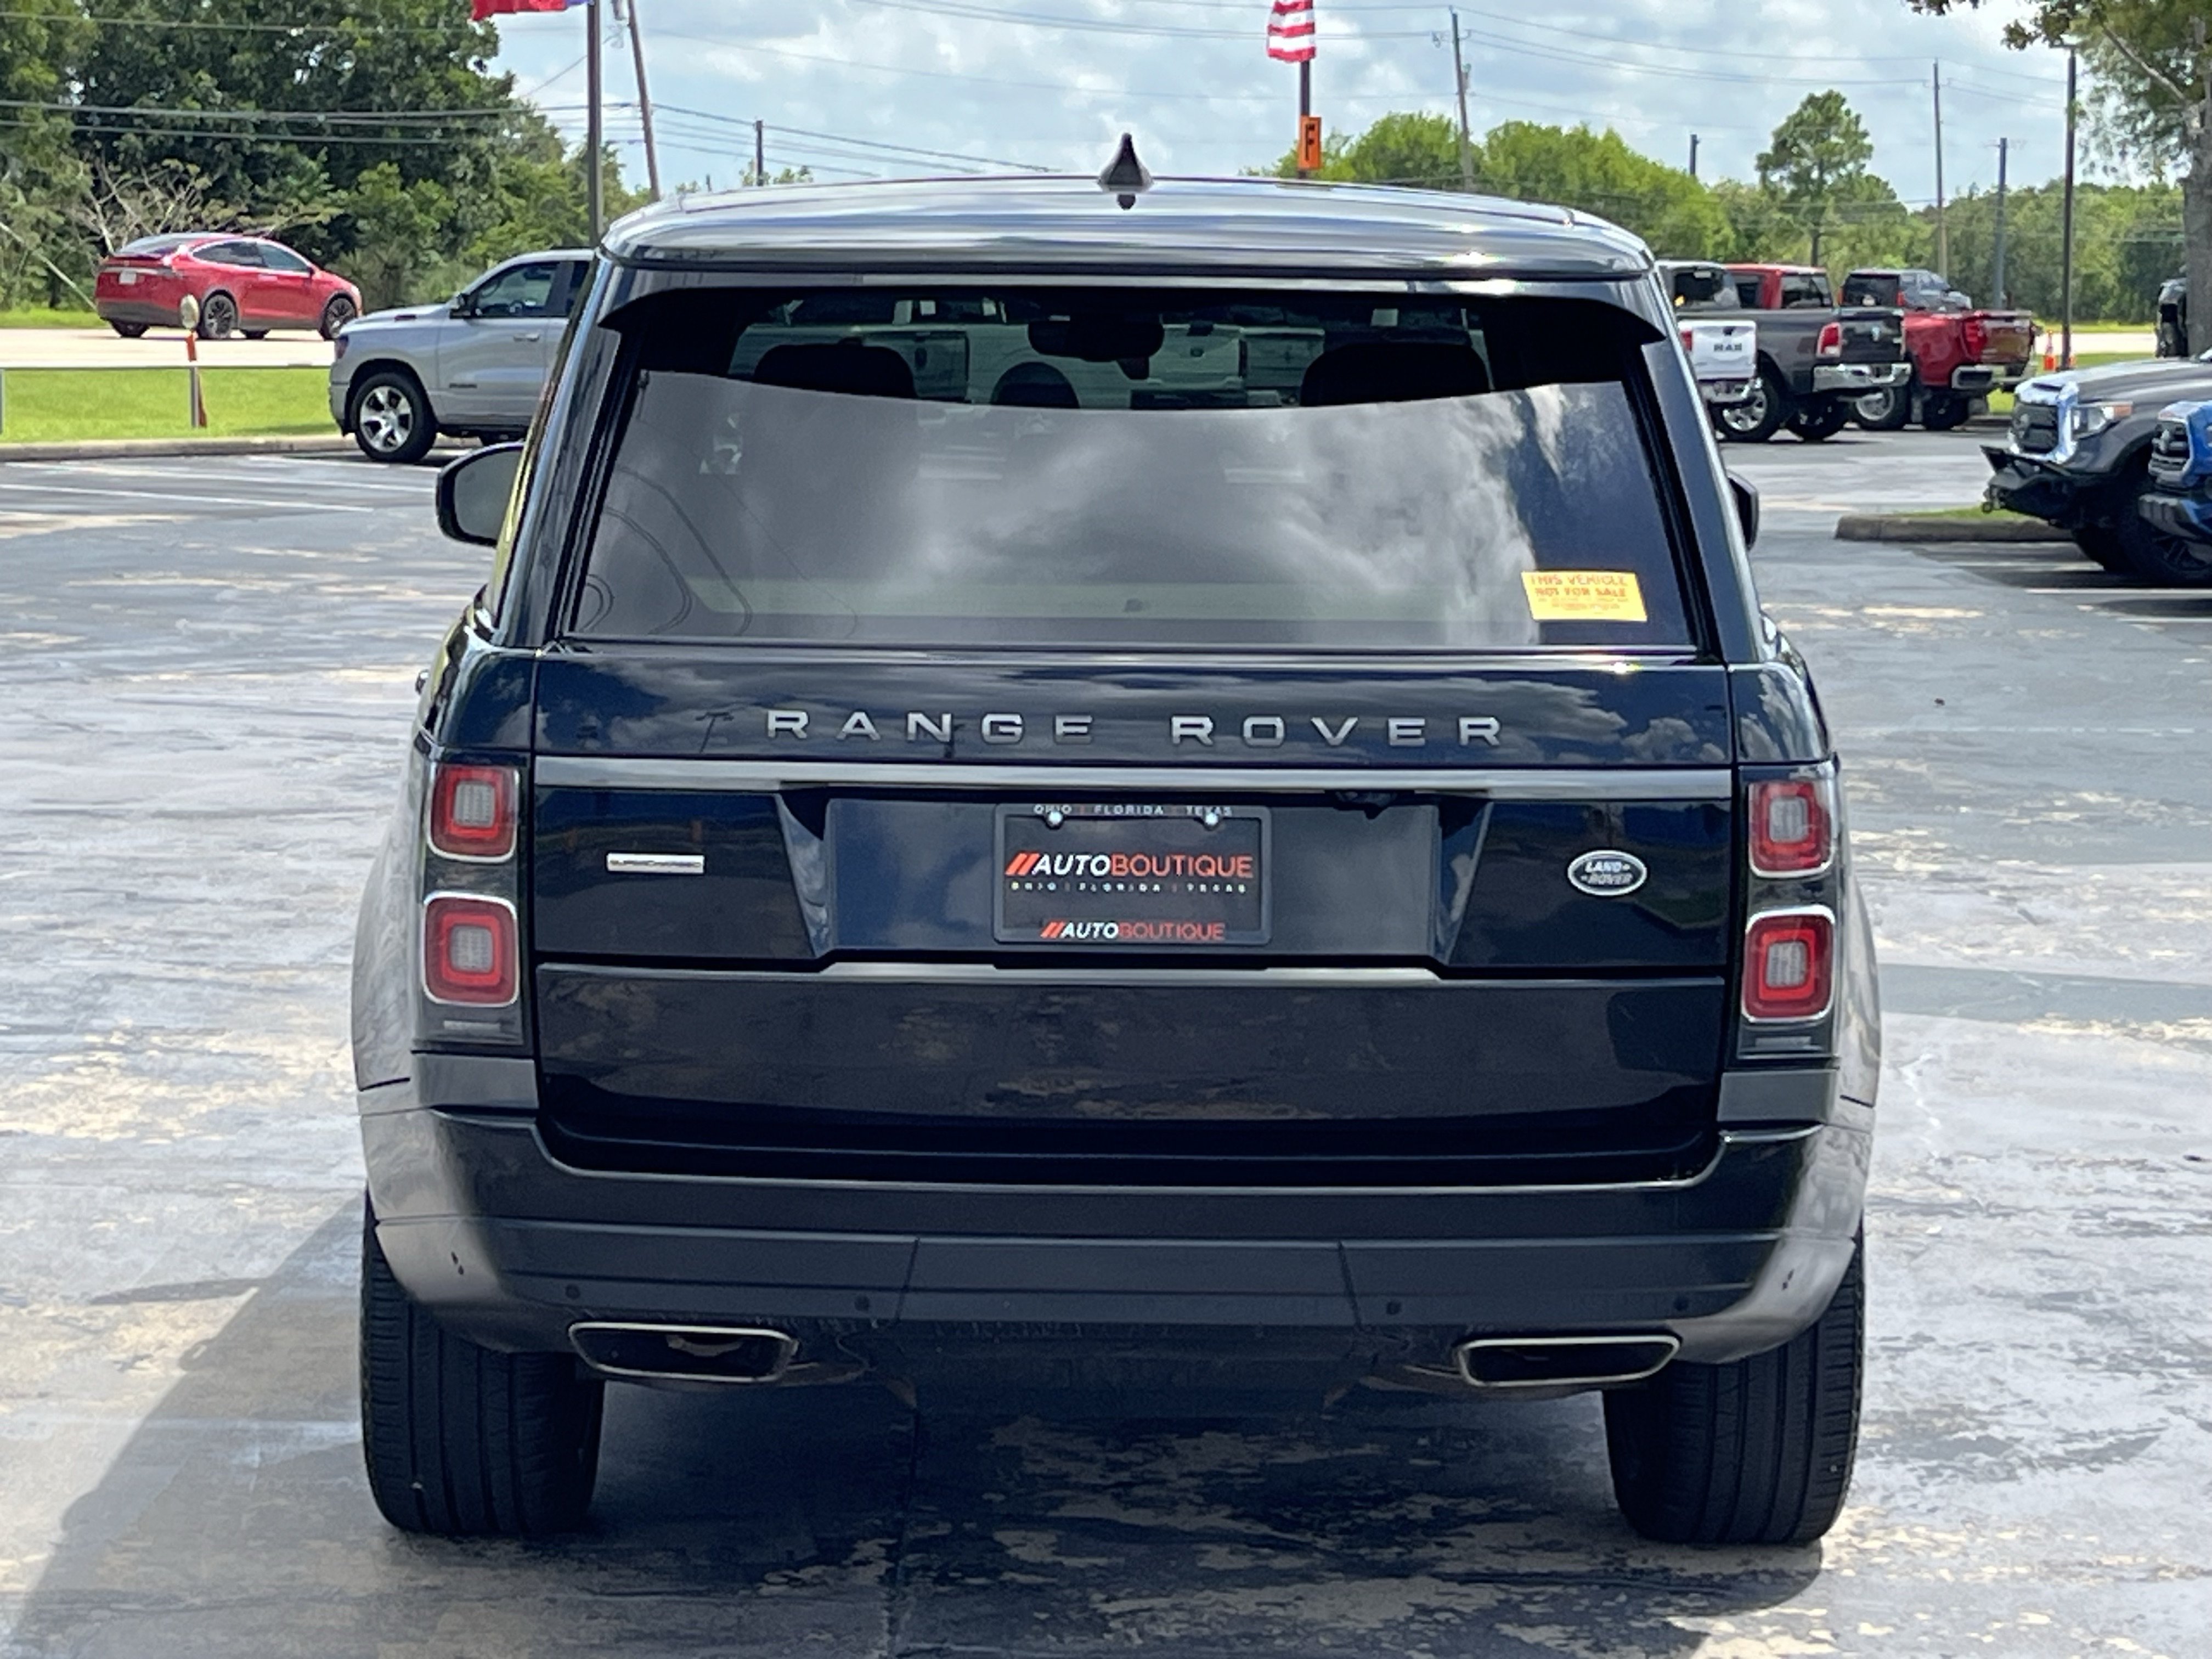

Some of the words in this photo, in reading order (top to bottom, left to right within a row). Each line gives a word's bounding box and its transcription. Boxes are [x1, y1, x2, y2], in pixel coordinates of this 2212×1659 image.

[768, 709, 1093, 744] RANGE
[1170, 716, 1501, 746] ROVER
[1094, 804, 1164, 815] FLORIDA
[1031, 853, 1254, 878] AUTOBOUTIQUE
[1060, 922, 1226, 940] AUTOBOUTIQUE
